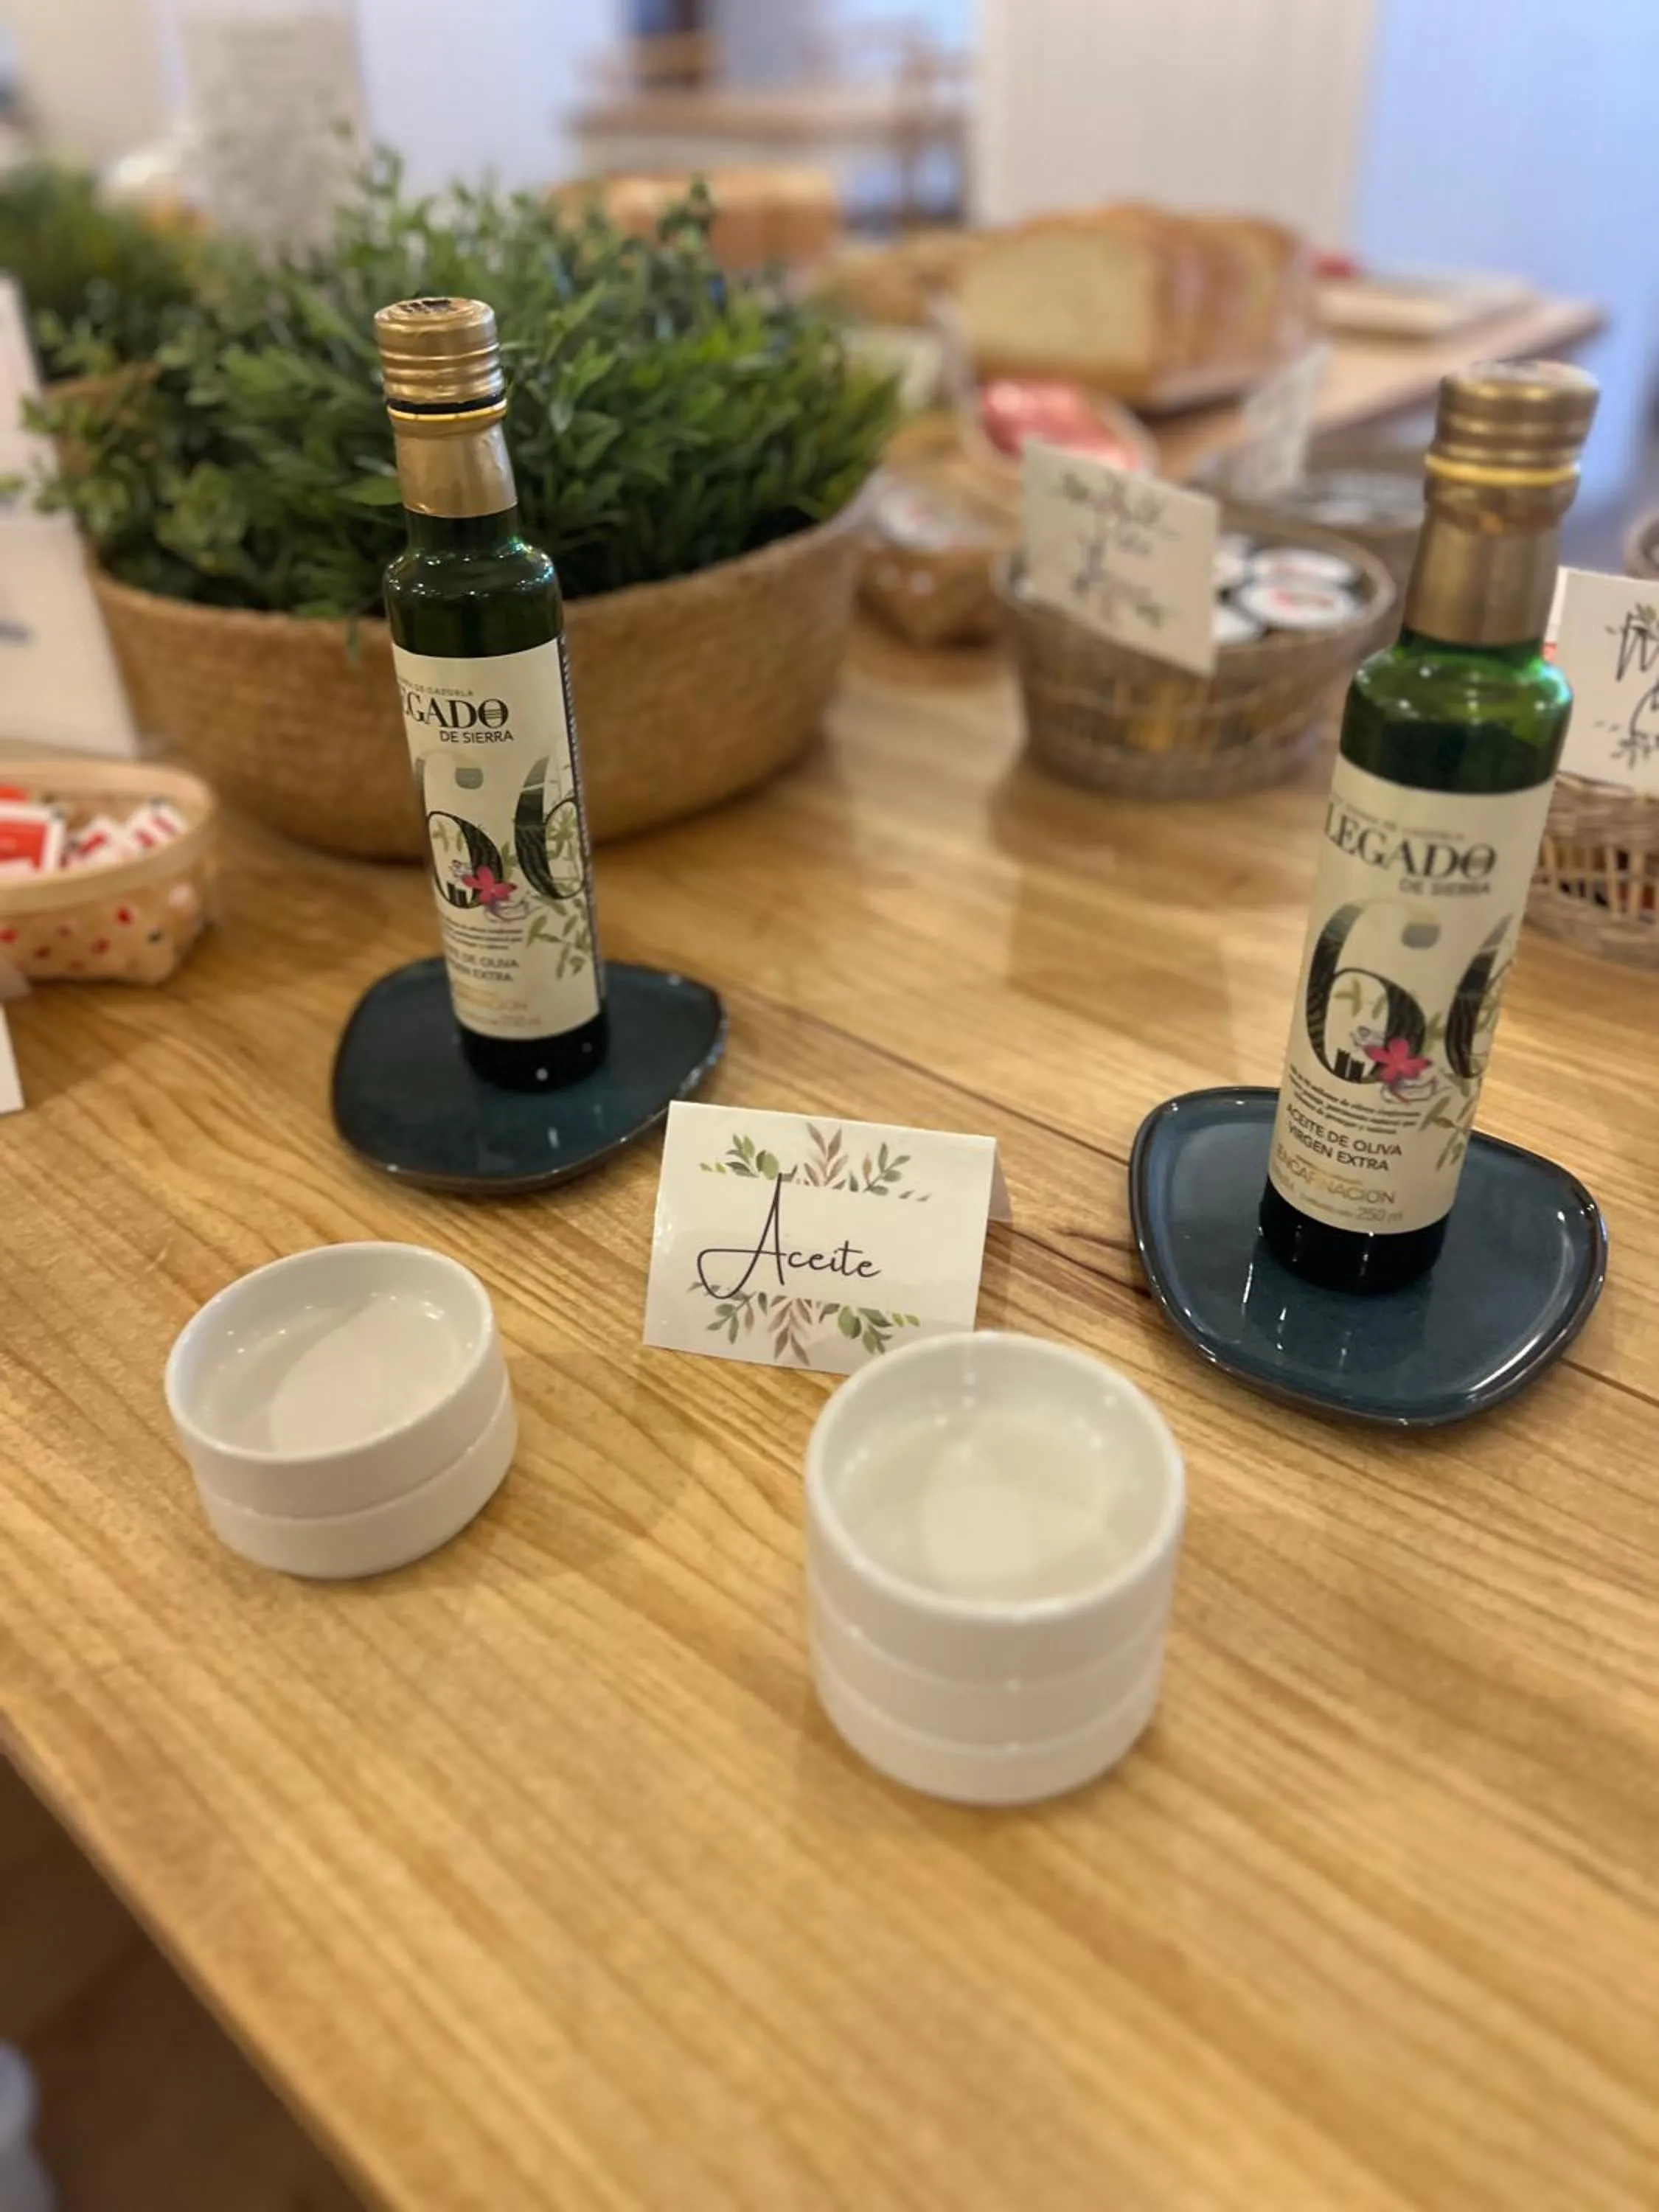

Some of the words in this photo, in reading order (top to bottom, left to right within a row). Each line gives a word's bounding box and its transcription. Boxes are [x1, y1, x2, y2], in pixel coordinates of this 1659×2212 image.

[439, 731, 459, 742] DE
[463, 730, 514, 743] SIERRA
[1325, 801, 1498, 880] LEGADO
[1287, 1104, 1325, 1138] ACEITE
[1327, 1130, 1350, 1148] DE
[1353, 1140, 1402, 1156] OLIVA
[1289, 1121, 1333, 1158] VIRGEN
[1336, 1151, 1390, 1171] EXTRA
[696, 1172, 882, 1299] Aceite
[1356, 1207, 1387, 1222] 250
